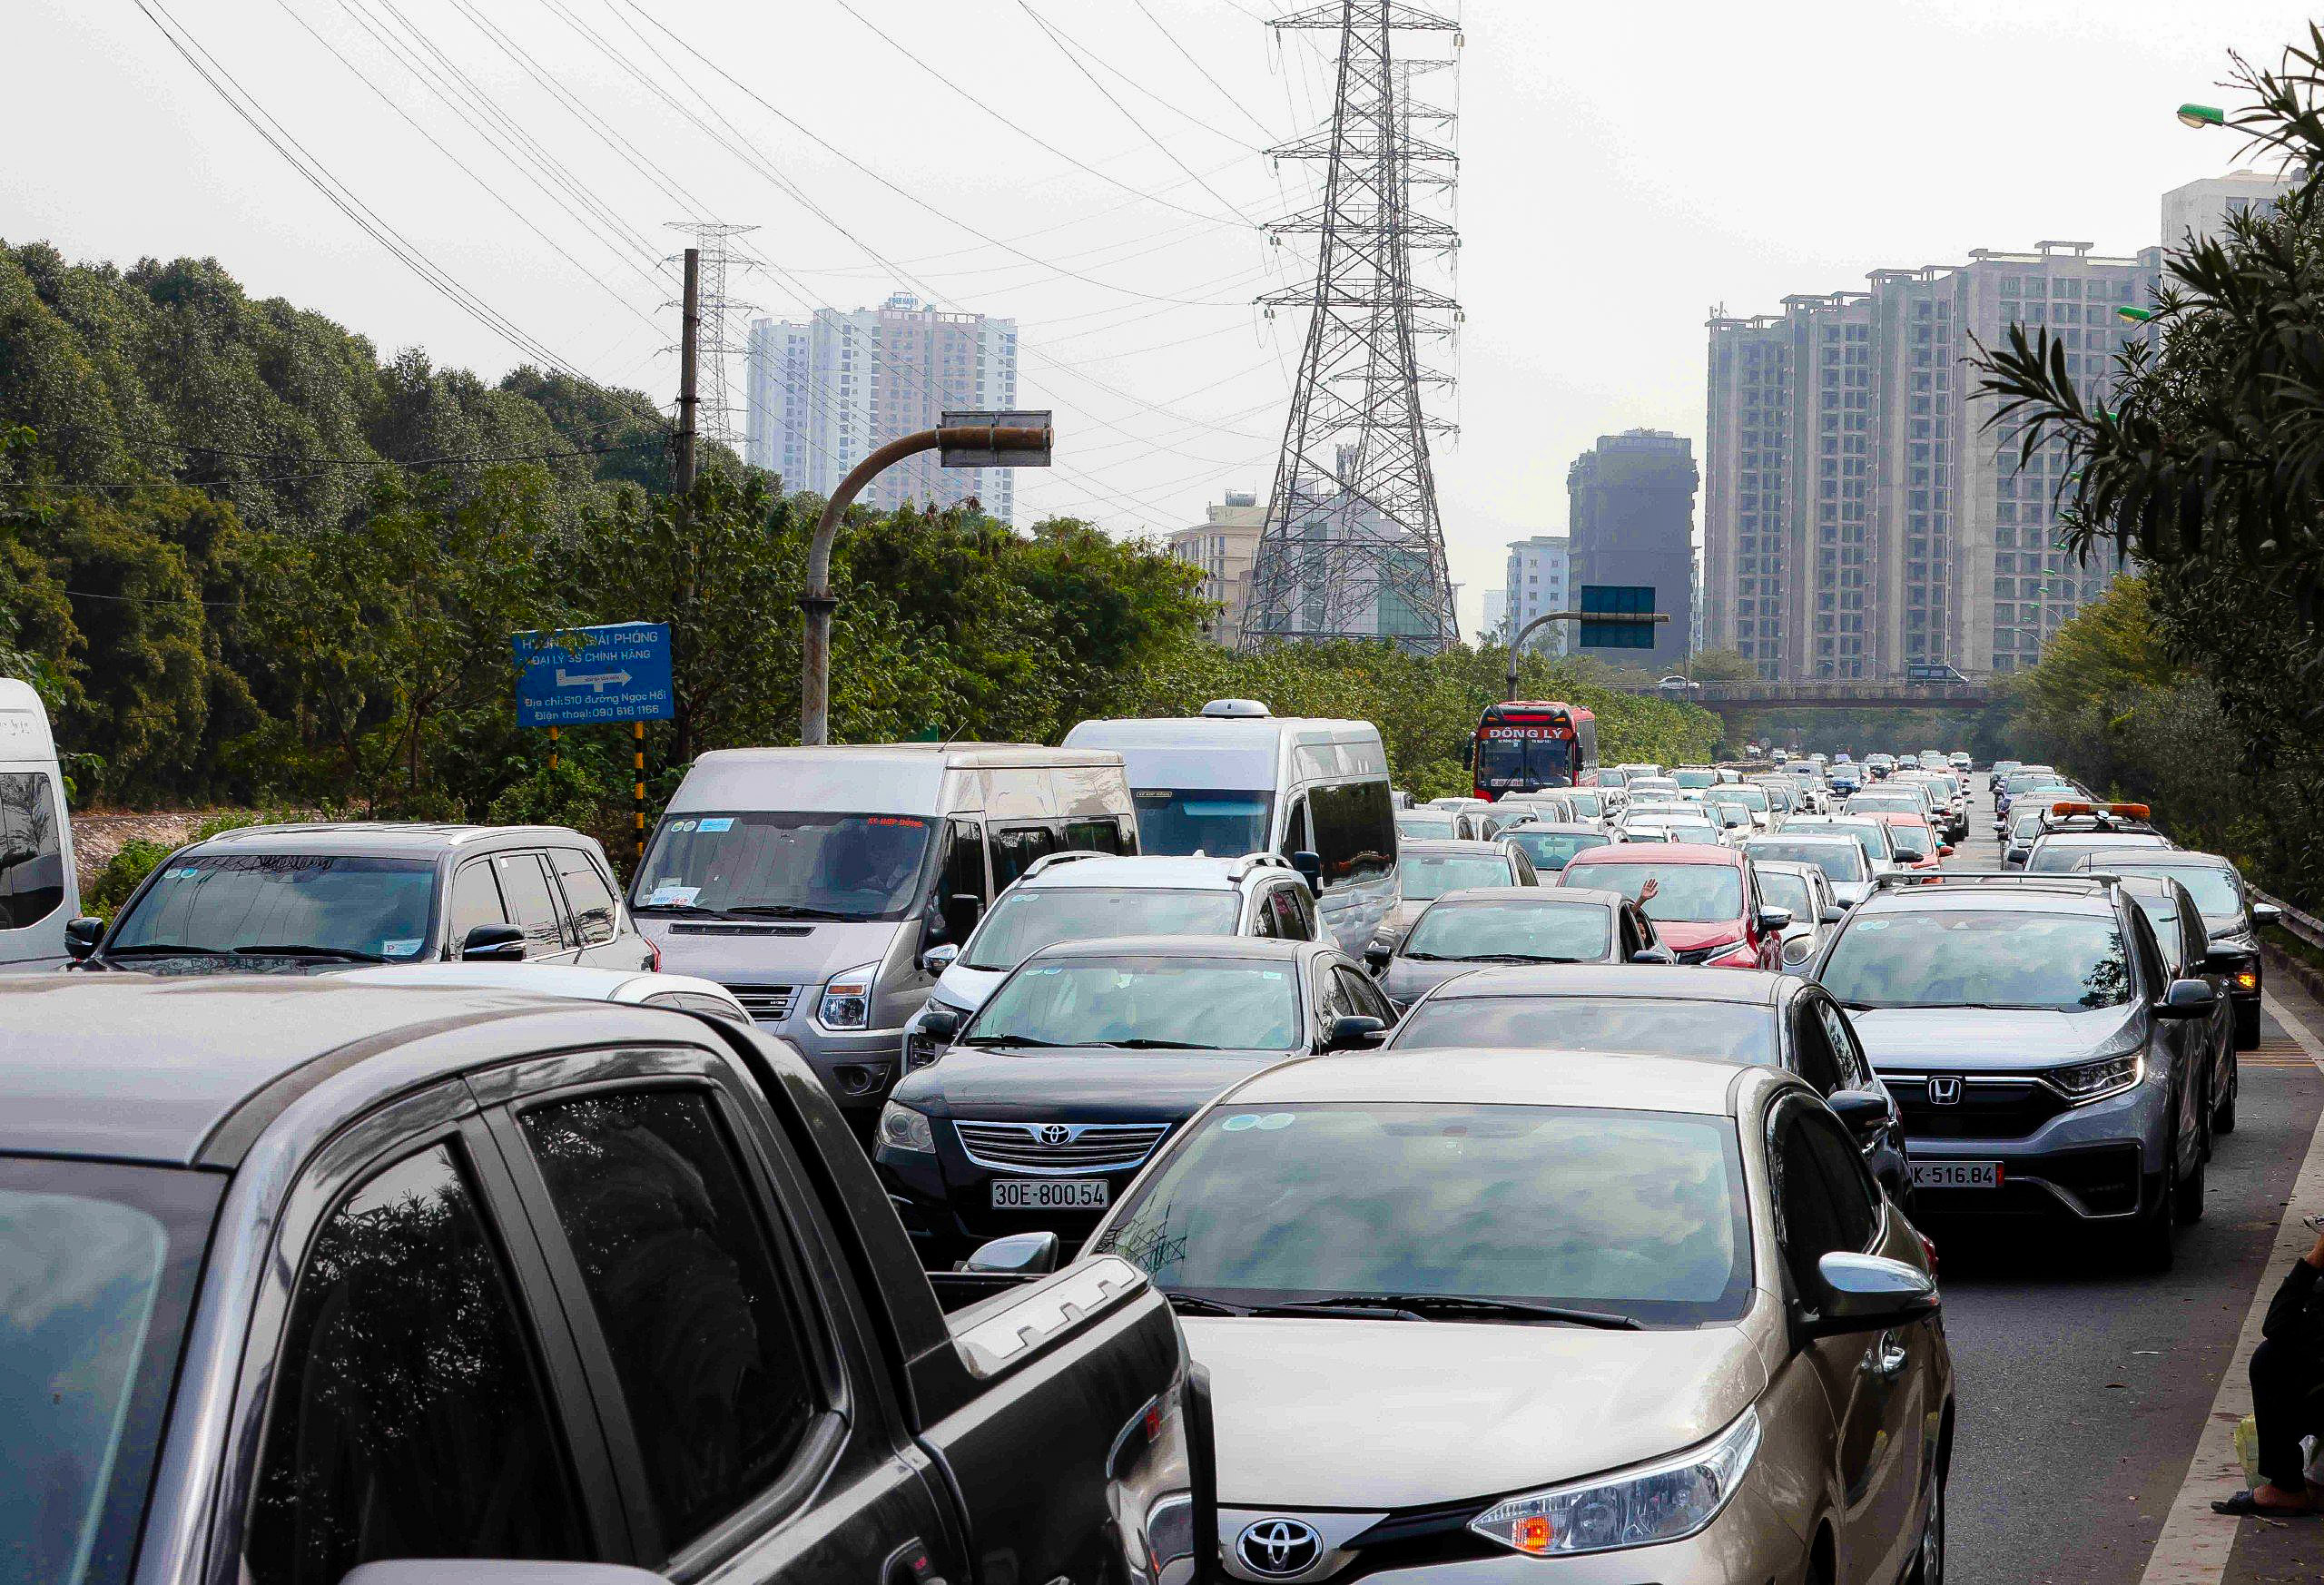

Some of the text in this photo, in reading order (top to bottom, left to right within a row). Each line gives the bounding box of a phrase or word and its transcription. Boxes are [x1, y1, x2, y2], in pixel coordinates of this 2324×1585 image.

[1543, 727, 1563, 739] LÝ
[1909, 1167, 1994, 1184] K-516.84
[995, 1184, 1105, 1206] 30E-800.54
